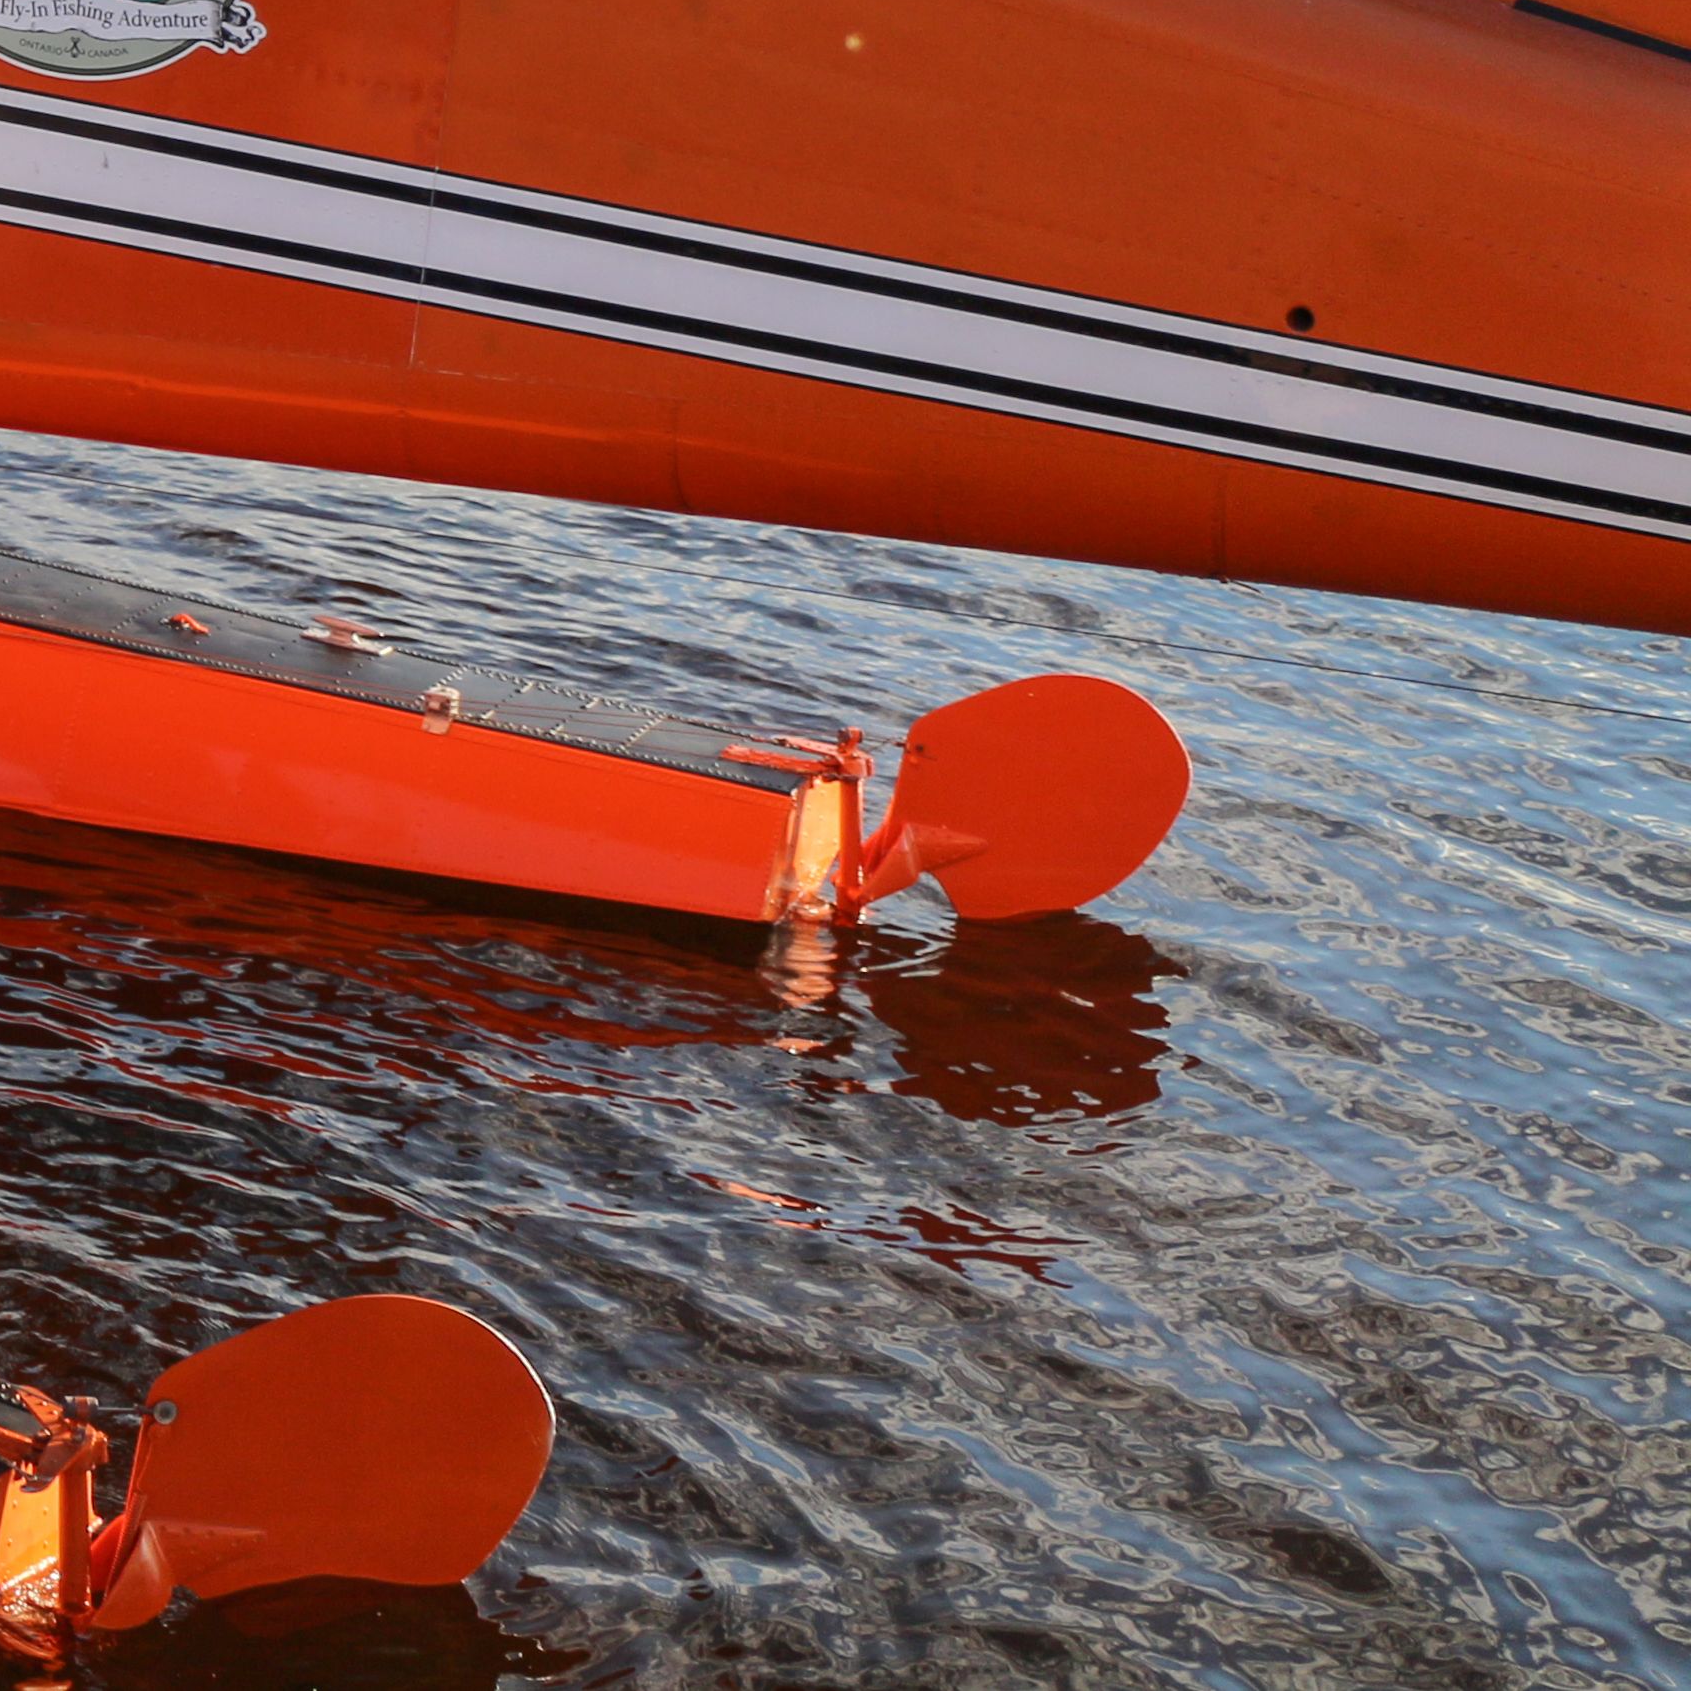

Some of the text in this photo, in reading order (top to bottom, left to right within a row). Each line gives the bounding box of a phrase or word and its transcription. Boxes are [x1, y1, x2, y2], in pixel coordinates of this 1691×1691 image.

[118, 9, 209, 29] Adventure
[19, 37, 129, 58] ONTARIO CANADA
